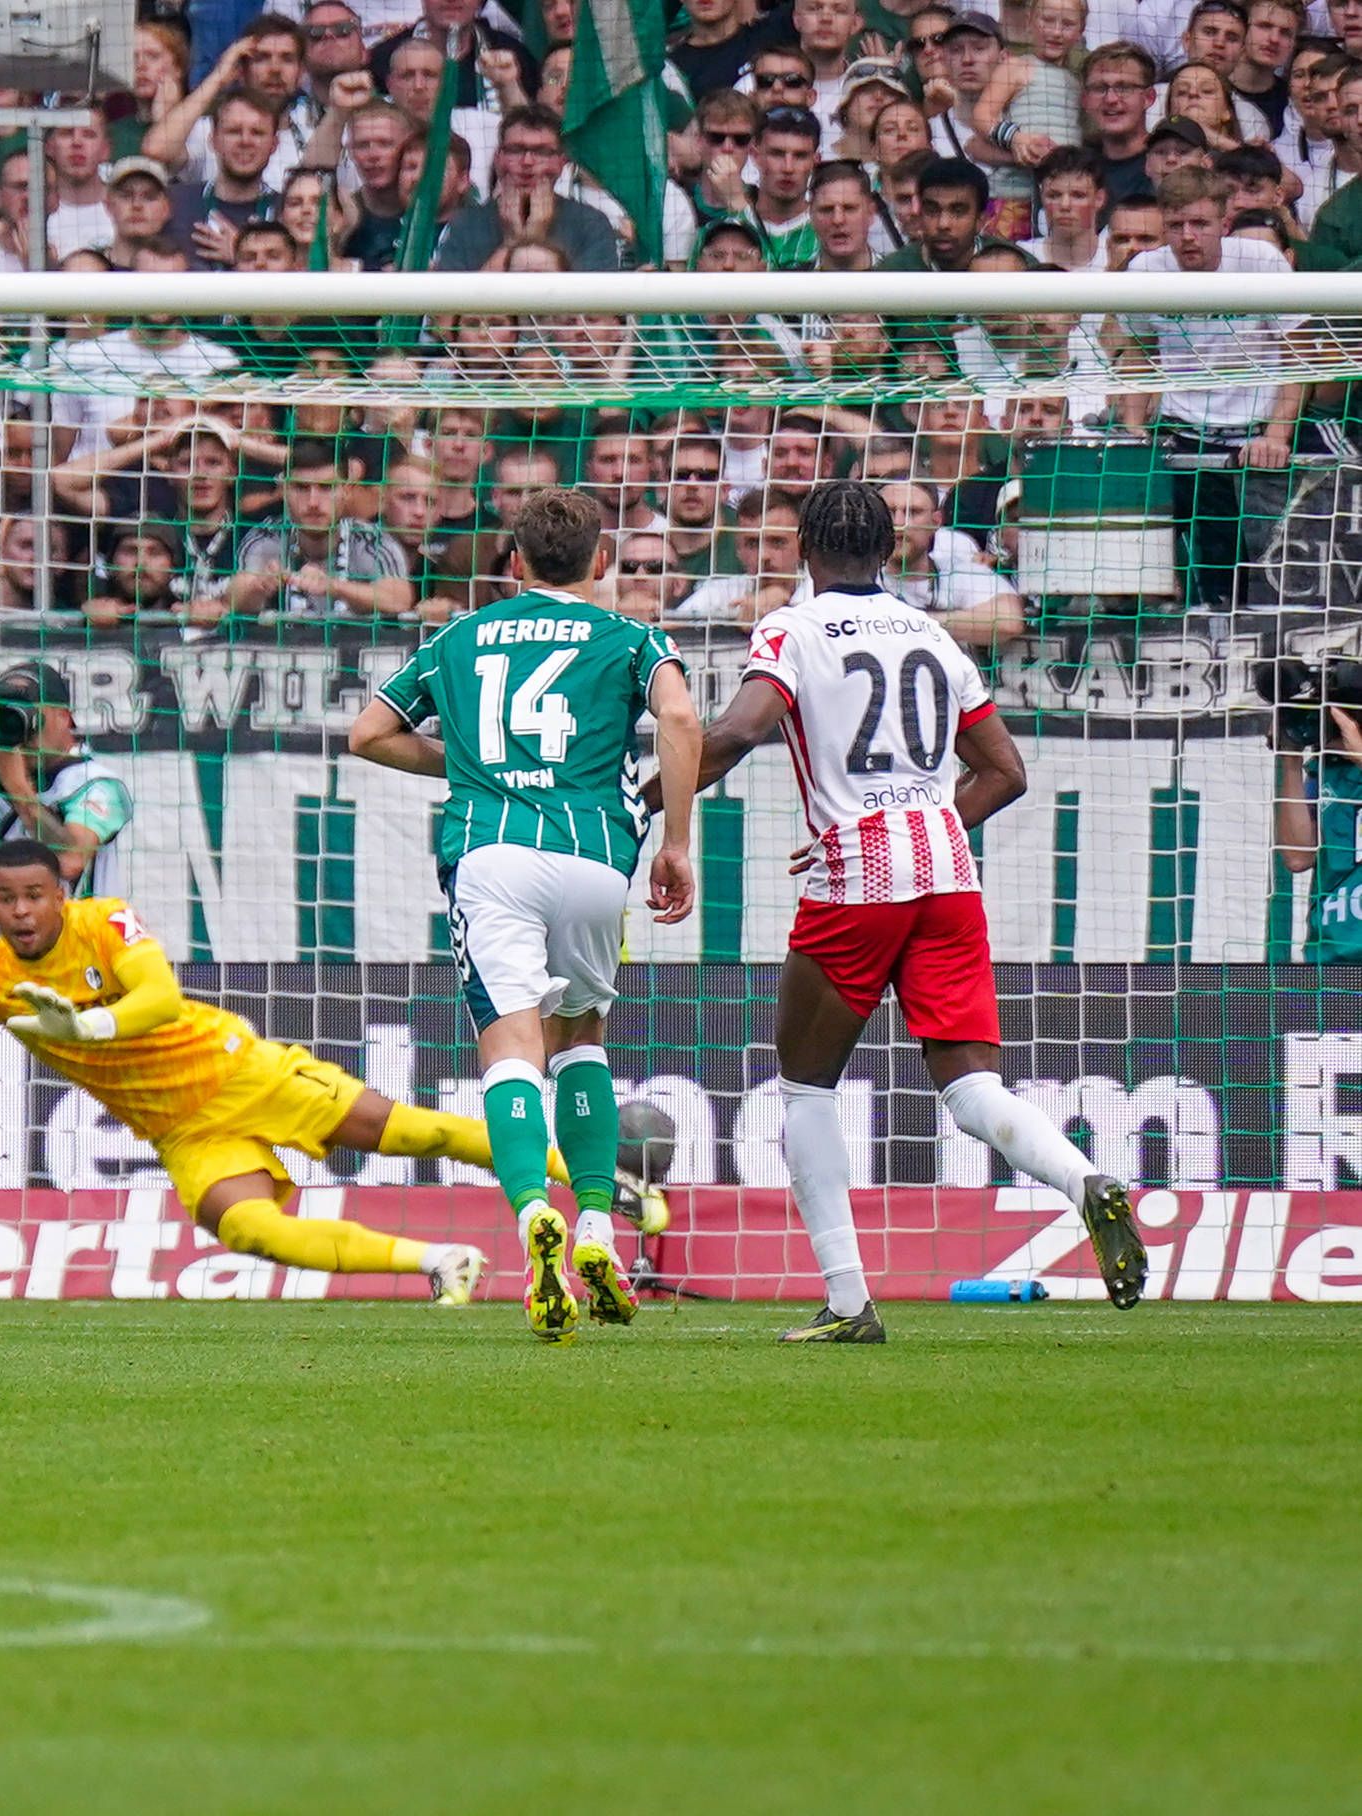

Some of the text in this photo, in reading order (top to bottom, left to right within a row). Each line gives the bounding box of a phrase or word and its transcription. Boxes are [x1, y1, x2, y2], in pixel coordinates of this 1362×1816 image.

[476, 618, 592, 647] WERDER
[474, 648, 580, 765] 14
[841, 648, 949, 776] 20
